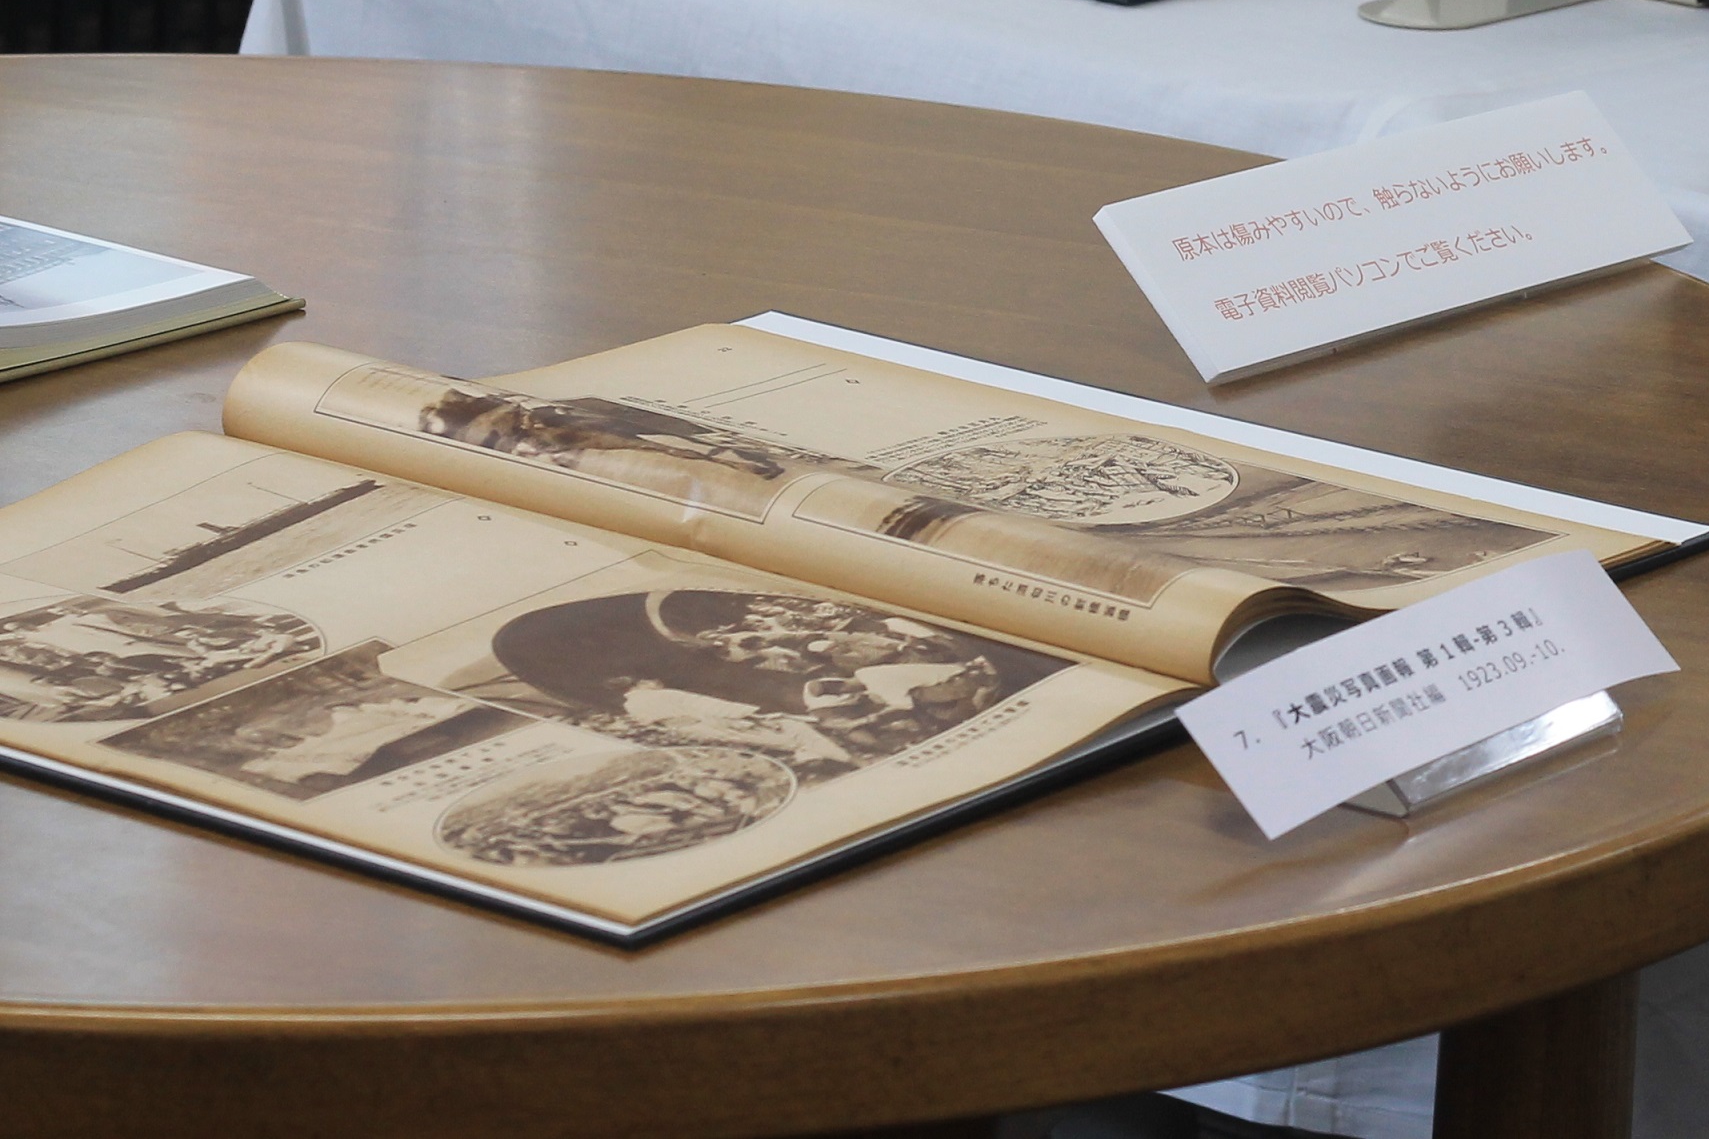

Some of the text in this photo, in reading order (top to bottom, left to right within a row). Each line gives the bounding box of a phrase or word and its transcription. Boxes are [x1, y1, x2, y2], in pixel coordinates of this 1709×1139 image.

[1172, 136, 1608, 262] 原本は傷みやすいので、触らないようにお願いします。
[1214, 224, 1534, 321] 電子資料閲覧パソコンでご覧ください。
[1233, 730, 1261, 750] 7.
[1301, 639, 1566, 760] 大阪朝日新聞社編 1923.09.-10.
